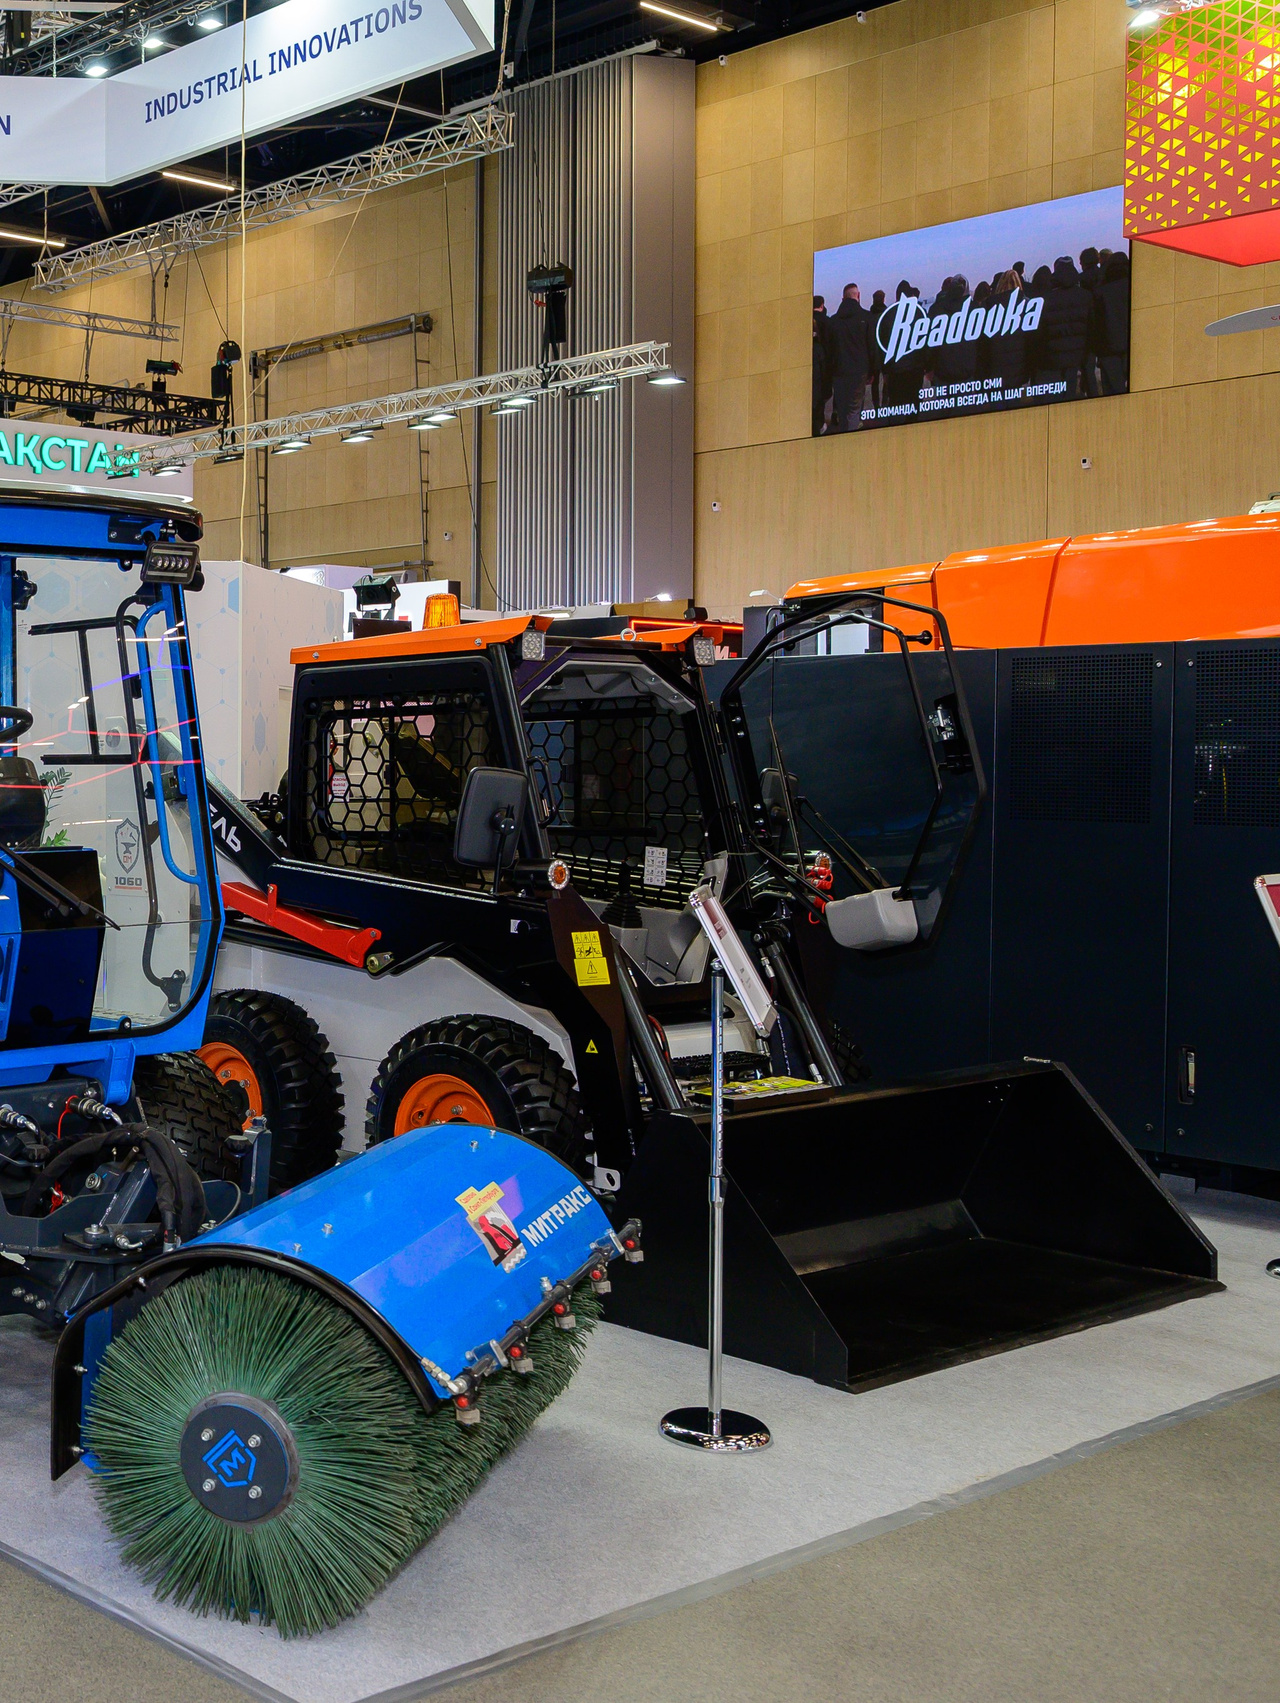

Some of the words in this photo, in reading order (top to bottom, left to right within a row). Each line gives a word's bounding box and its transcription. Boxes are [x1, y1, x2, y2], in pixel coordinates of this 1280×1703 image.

[145, 59, 263, 124] INDUSTRIAL
[268, 0, 423, 76] INNOVATIONS
[880, 287, 1044, 364] Readovka
[860, 409, 876, 420] ЭТО
[877, 403, 918, 418] КОМАНДА,
[919, 398, 955, 412] КОТОРАЯ
[957, 393, 989, 407] ВСЕГДА
[990, 391, 1002, 402] НА
[1004, 387, 1024, 400] ШАГ
[1026, 381, 1067, 397] ВПЕРЕДИ
[918, 387, 934, 399] ЭТО
[936, 386, 947, 397] НЕ
[949, 380, 981, 395] ПРОСТО
[983, 377, 1002, 390] СМИ
[114, 876, 143, 886] 1060
[520, 1185, 593, 1248] МИТРАКС
